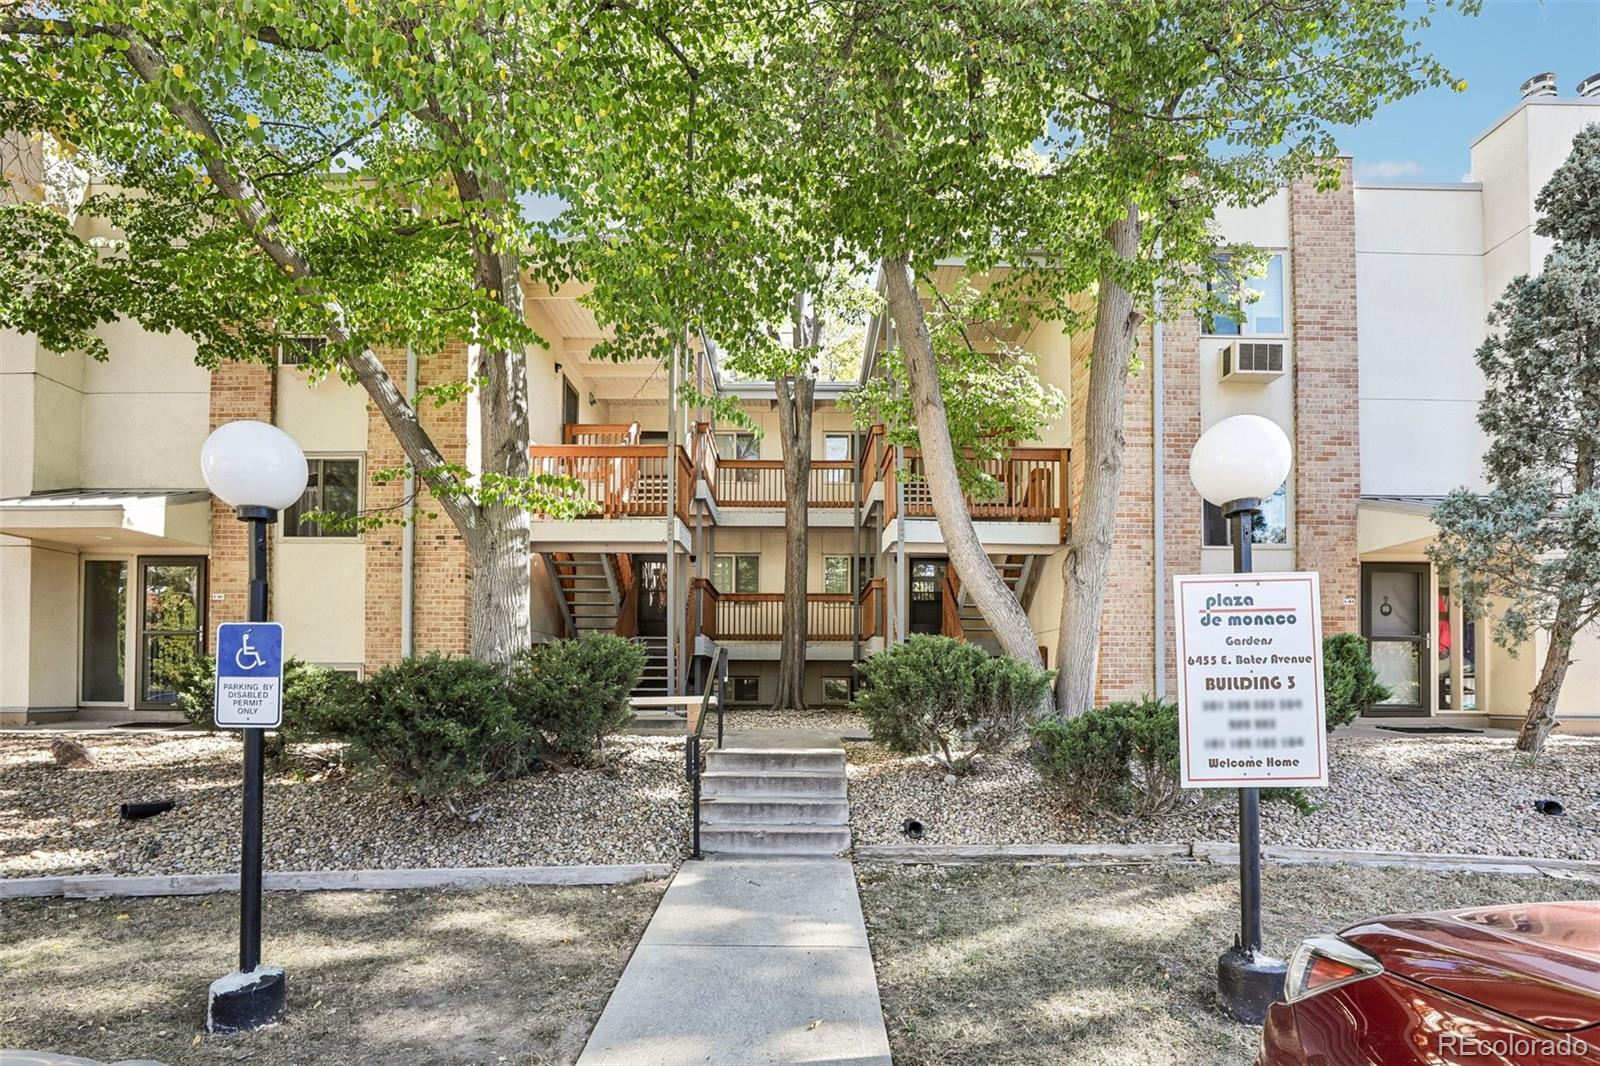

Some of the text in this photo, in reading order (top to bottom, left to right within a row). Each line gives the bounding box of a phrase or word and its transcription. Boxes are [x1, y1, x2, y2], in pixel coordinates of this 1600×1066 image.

[1206, 593, 1254, 610] plaza
[1200, 613, 1297, 626] de monaco
[1225, 636, 1273, 646] Gardens
[1187, 654, 1312, 665] 6455 E. Bates Avenue
[1205, 676, 1296, 691] BUILDING 3
[1208, 757, 1300, 768] Welcome Home
